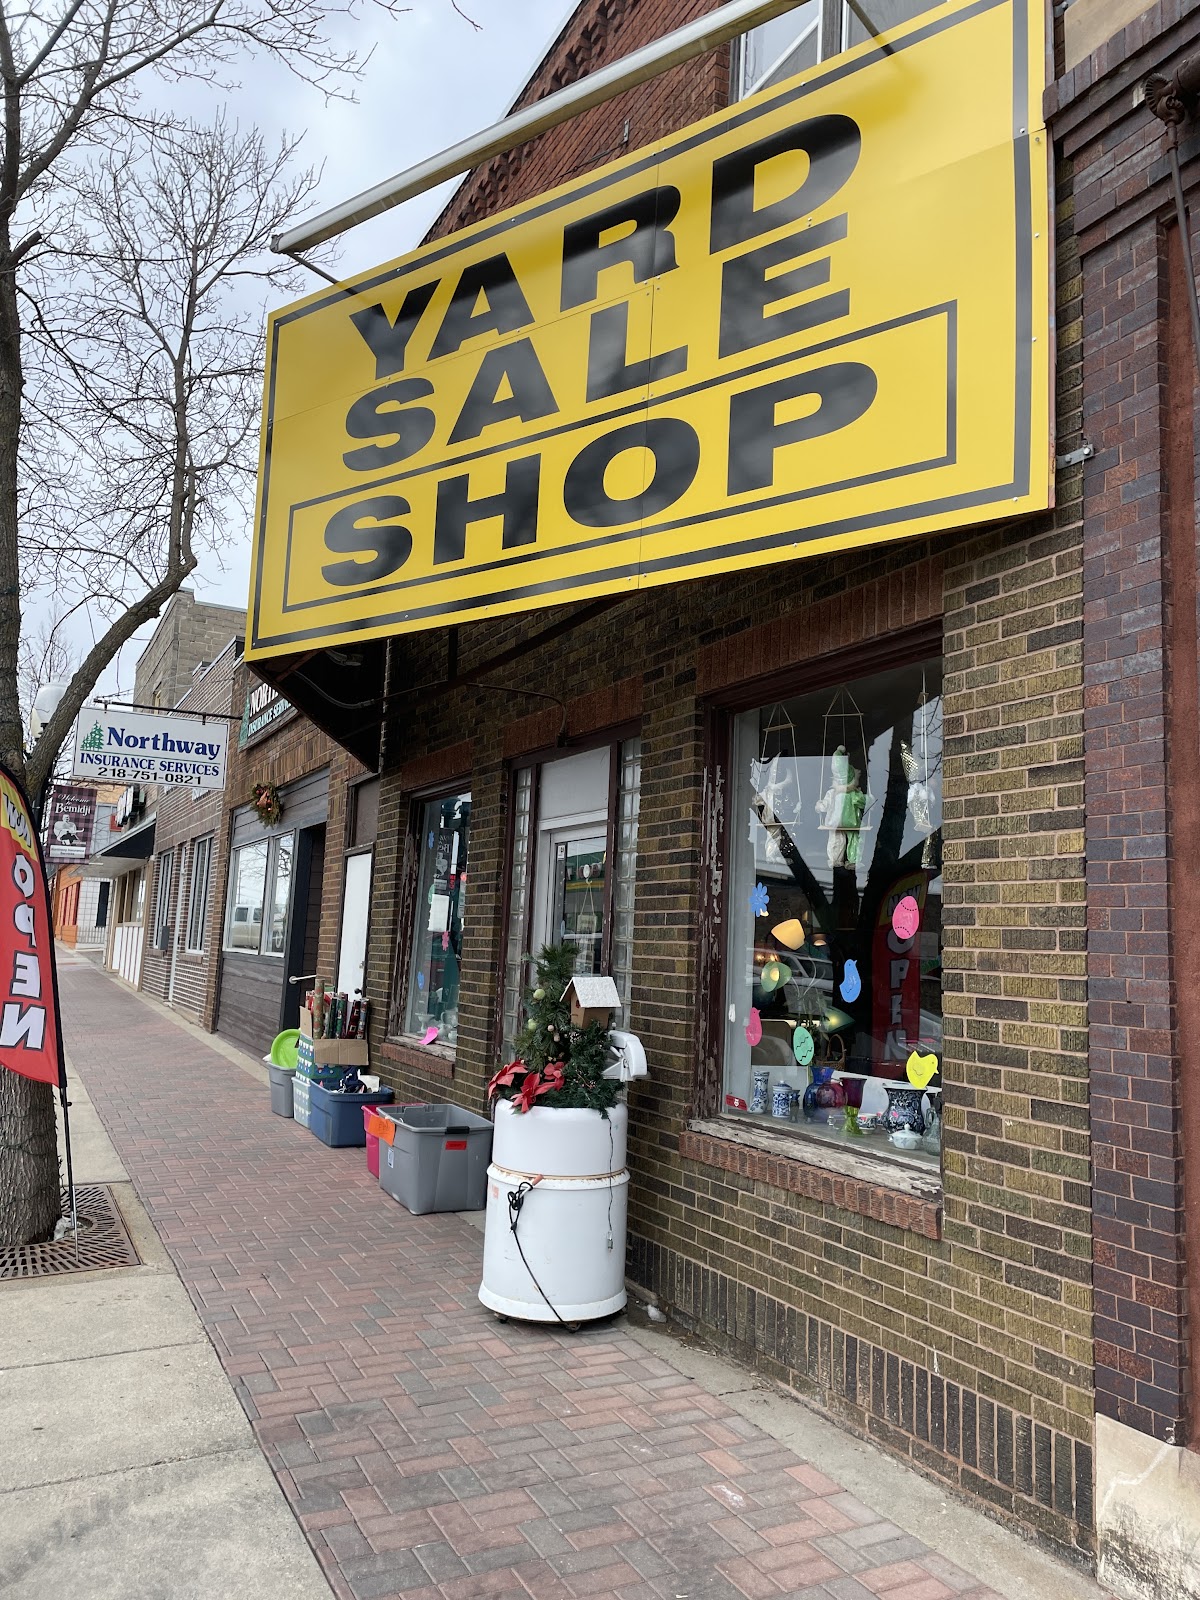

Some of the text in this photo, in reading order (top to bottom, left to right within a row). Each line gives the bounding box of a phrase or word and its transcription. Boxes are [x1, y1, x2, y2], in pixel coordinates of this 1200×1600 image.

[350, 113, 862, 381] YARD
[342, 212, 850, 472] SALE
[320, 361, 879, 587] SHOP
[106, 726, 221, 761] Northway
[80, 752, 219, 776] INSURANCE SERVICES
[97, 767, 202, 785] 218-751-0821
[55, 802, 91, 816] Bemidji
